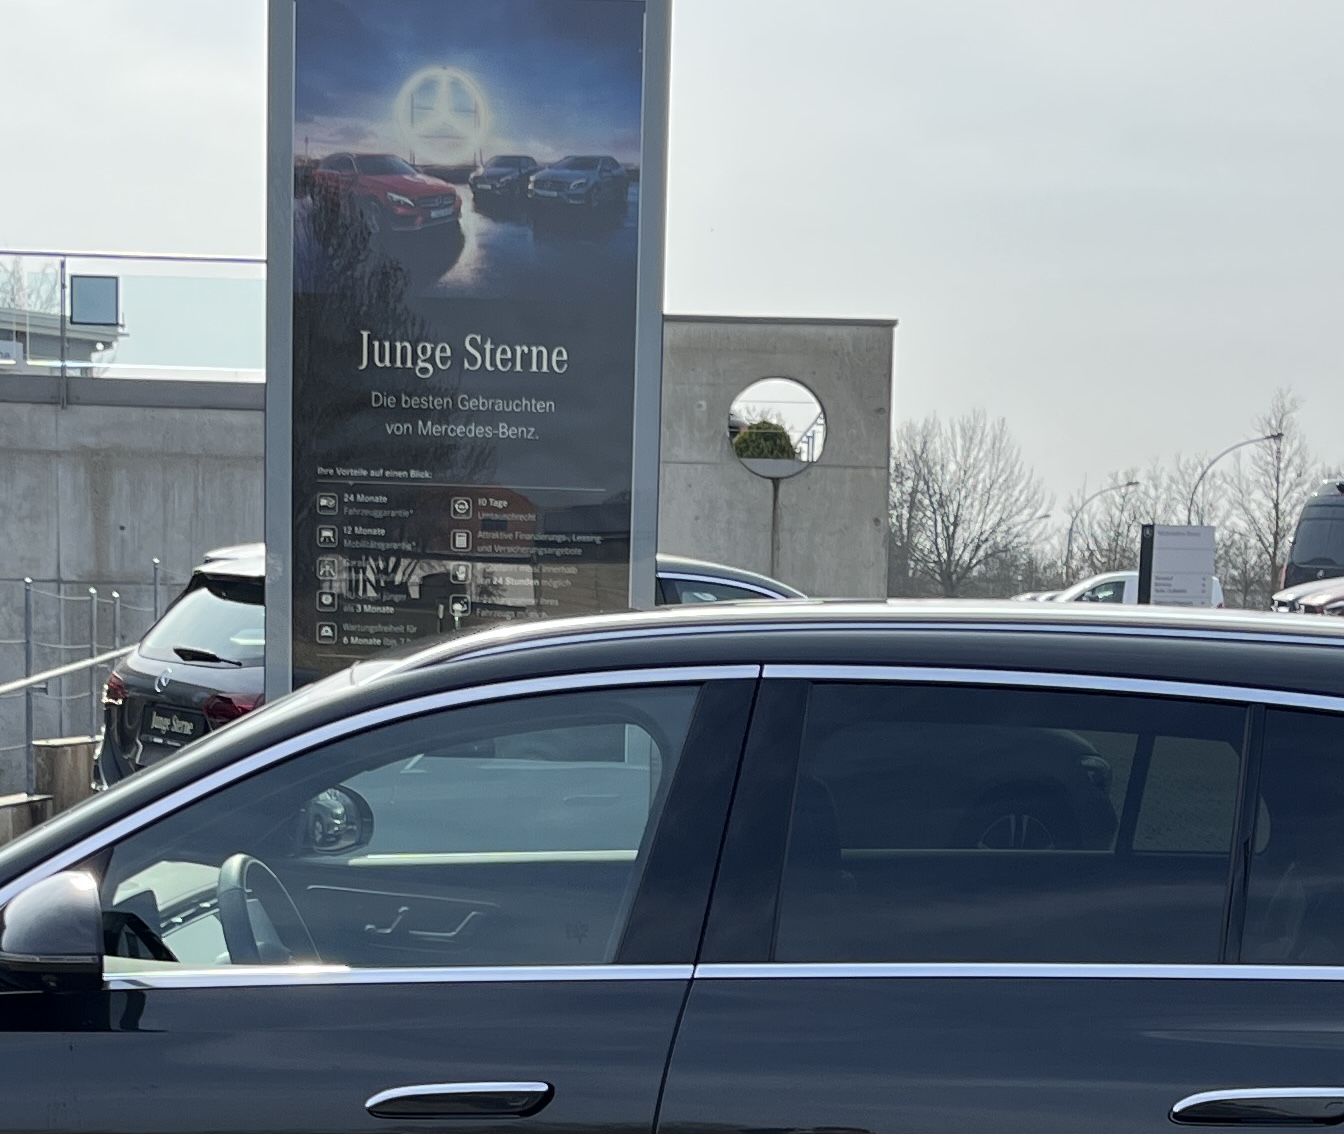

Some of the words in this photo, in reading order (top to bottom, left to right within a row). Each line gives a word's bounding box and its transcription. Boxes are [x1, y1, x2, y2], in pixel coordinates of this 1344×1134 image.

[358, 330, 452, 379] Junge
[463, 333, 568, 374] Sterne
[371, 391, 396, 408] Die
[401, 392, 453, 410] besten
[457, 394, 555, 413] Gebrauchten
[385, 422, 413, 436] von
[418, 420, 540, 440] Mercedes-Benz.
[317, 467, 334, 476] Ihre
[336, 467, 368, 477] Vorteile
[370, 468, 384, 477] auf
[385, 469, 408, 478] einen
[410, 469, 432, 479] Blick:
[344, 493, 355, 502] 24
[356, 494, 388, 504] Monate
[478, 498, 487, 506] 10
[489, 498, 508, 509] Tage
[343, 526, 352, 535] 12
[354, 526, 386, 537] Monate
[477, 544, 492, 553] und
[493, 577, 504, 585] 24
[356, 604, 362, 613] 3
[363, 604, 395, 614] Monate
[343, 636, 349, 645] 6
[350, 636, 382, 646] Monate
